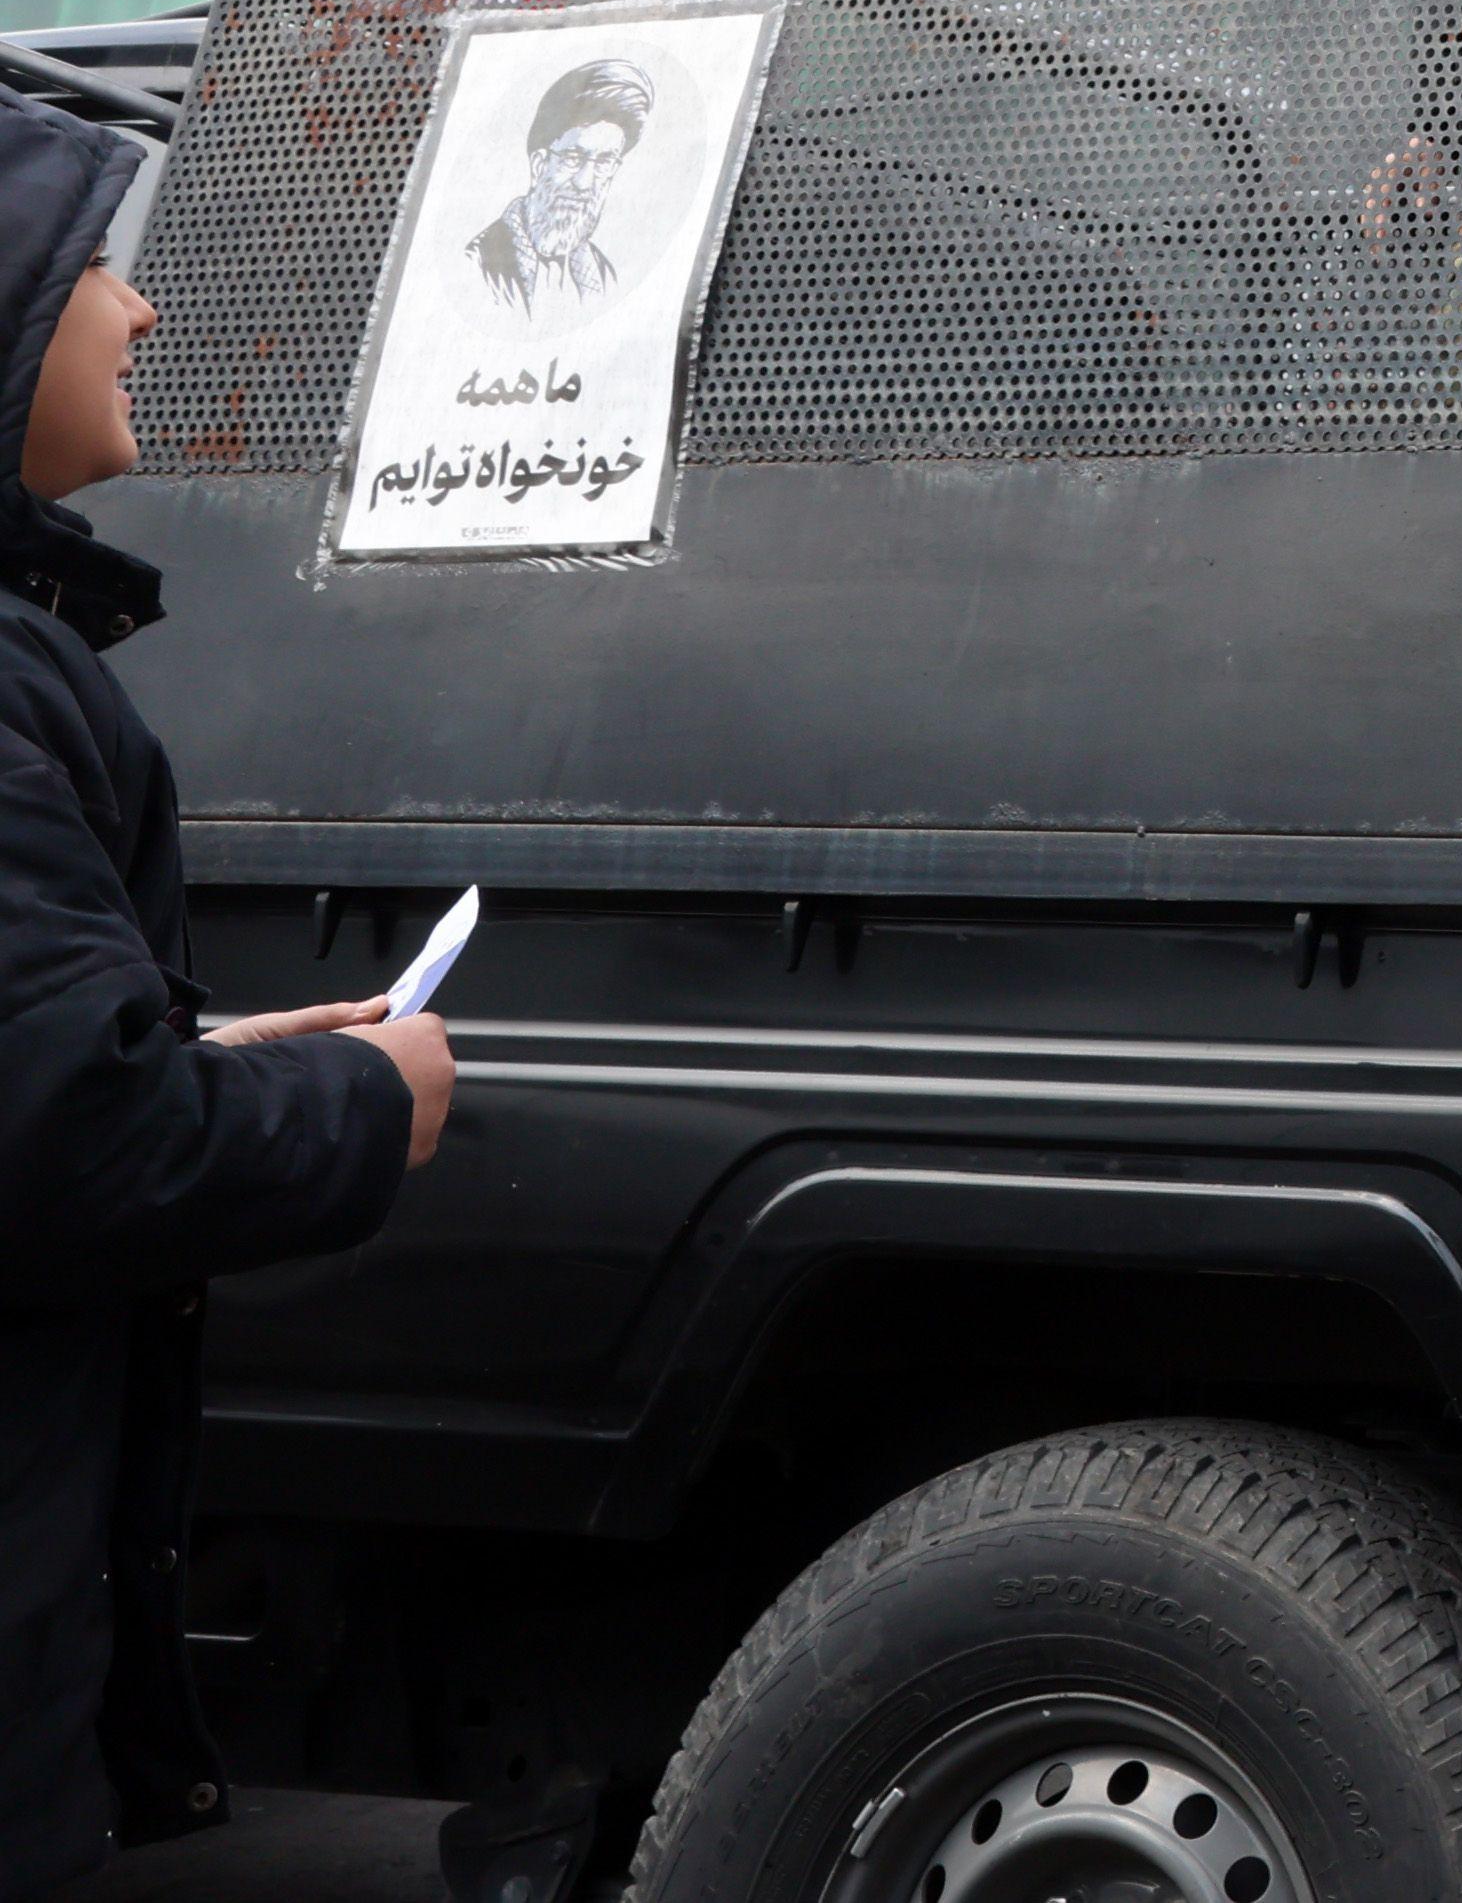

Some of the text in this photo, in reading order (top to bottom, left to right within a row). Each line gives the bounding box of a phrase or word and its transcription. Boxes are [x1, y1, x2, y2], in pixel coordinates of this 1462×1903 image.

[455, 358, 582, 409] ما همه
[369, 436, 645, 513] خونخواه توایم
[994, 1576, 1248, 1660] SPORTCAT
